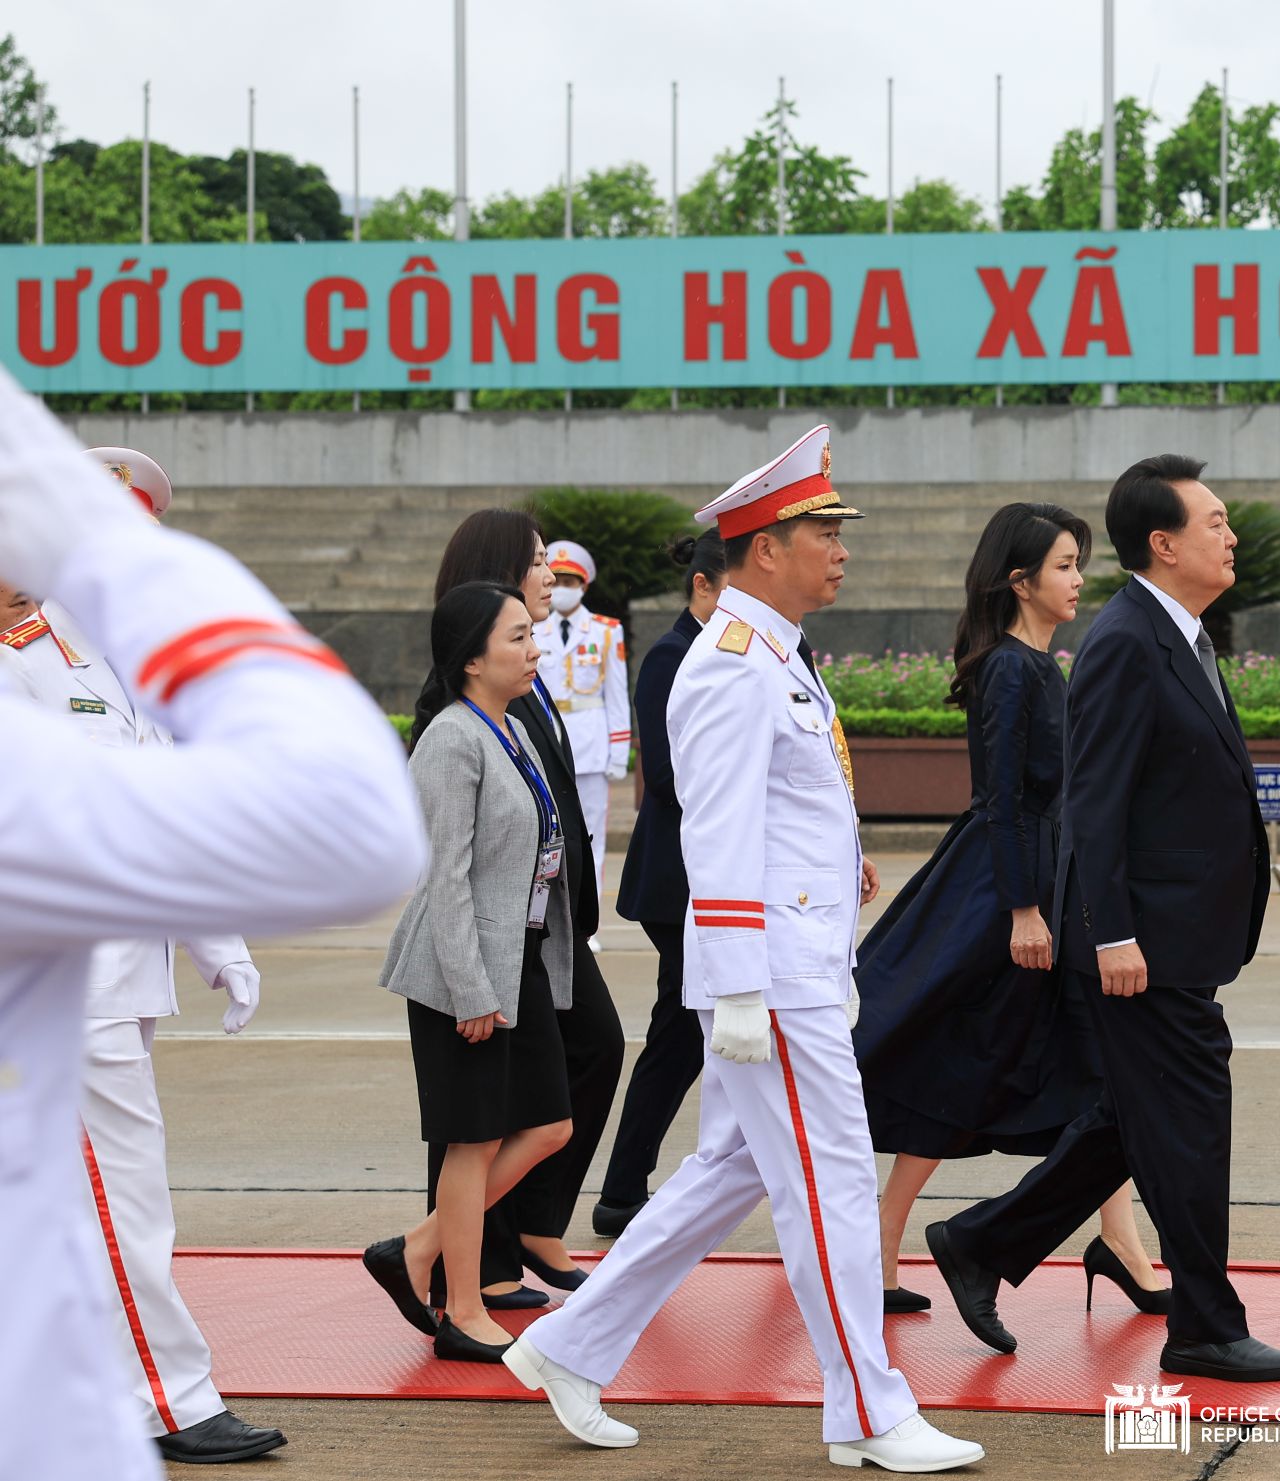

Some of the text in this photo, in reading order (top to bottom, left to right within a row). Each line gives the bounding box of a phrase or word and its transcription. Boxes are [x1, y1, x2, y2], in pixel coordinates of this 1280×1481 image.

[17, 258, 243, 367] ƯỚC
[304, 256, 620, 382] CỘNG
[683, 250, 919, 361] HÒA
[976, 246, 1132, 358] XÃ
